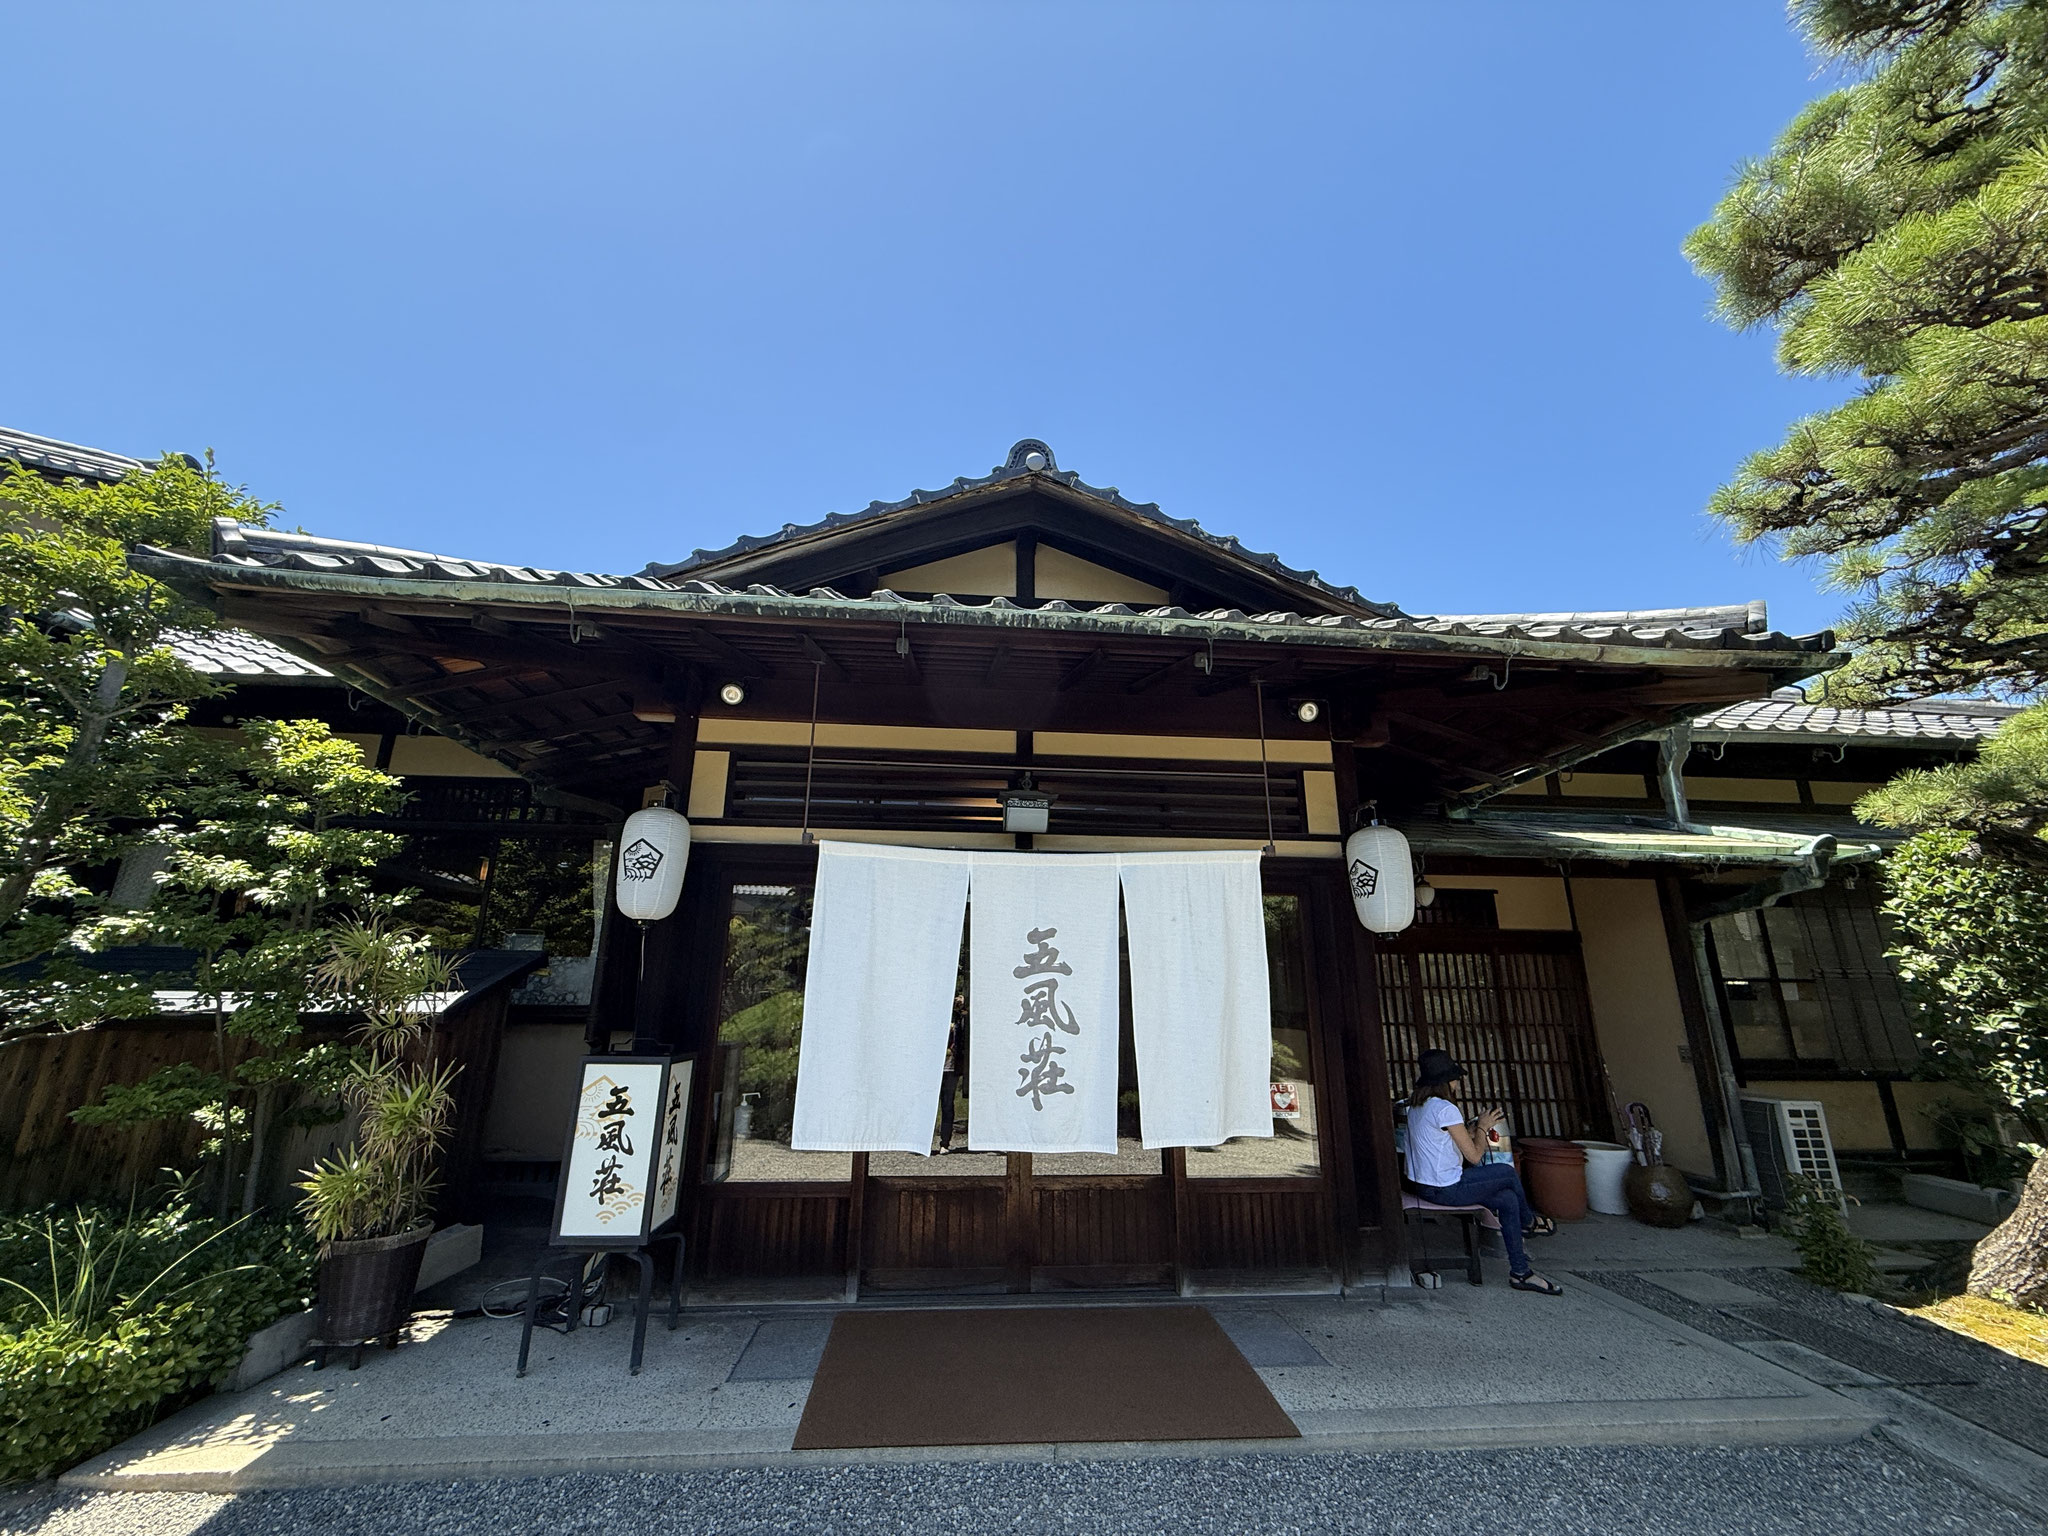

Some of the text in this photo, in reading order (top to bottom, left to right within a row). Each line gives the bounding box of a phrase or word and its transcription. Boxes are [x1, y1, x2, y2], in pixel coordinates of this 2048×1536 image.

[1013, 927, 1080, 1111] 五風荘
[590, 1086, 634, 1205] 五風荘
[1270, 1084, 1295, 1092] AED
